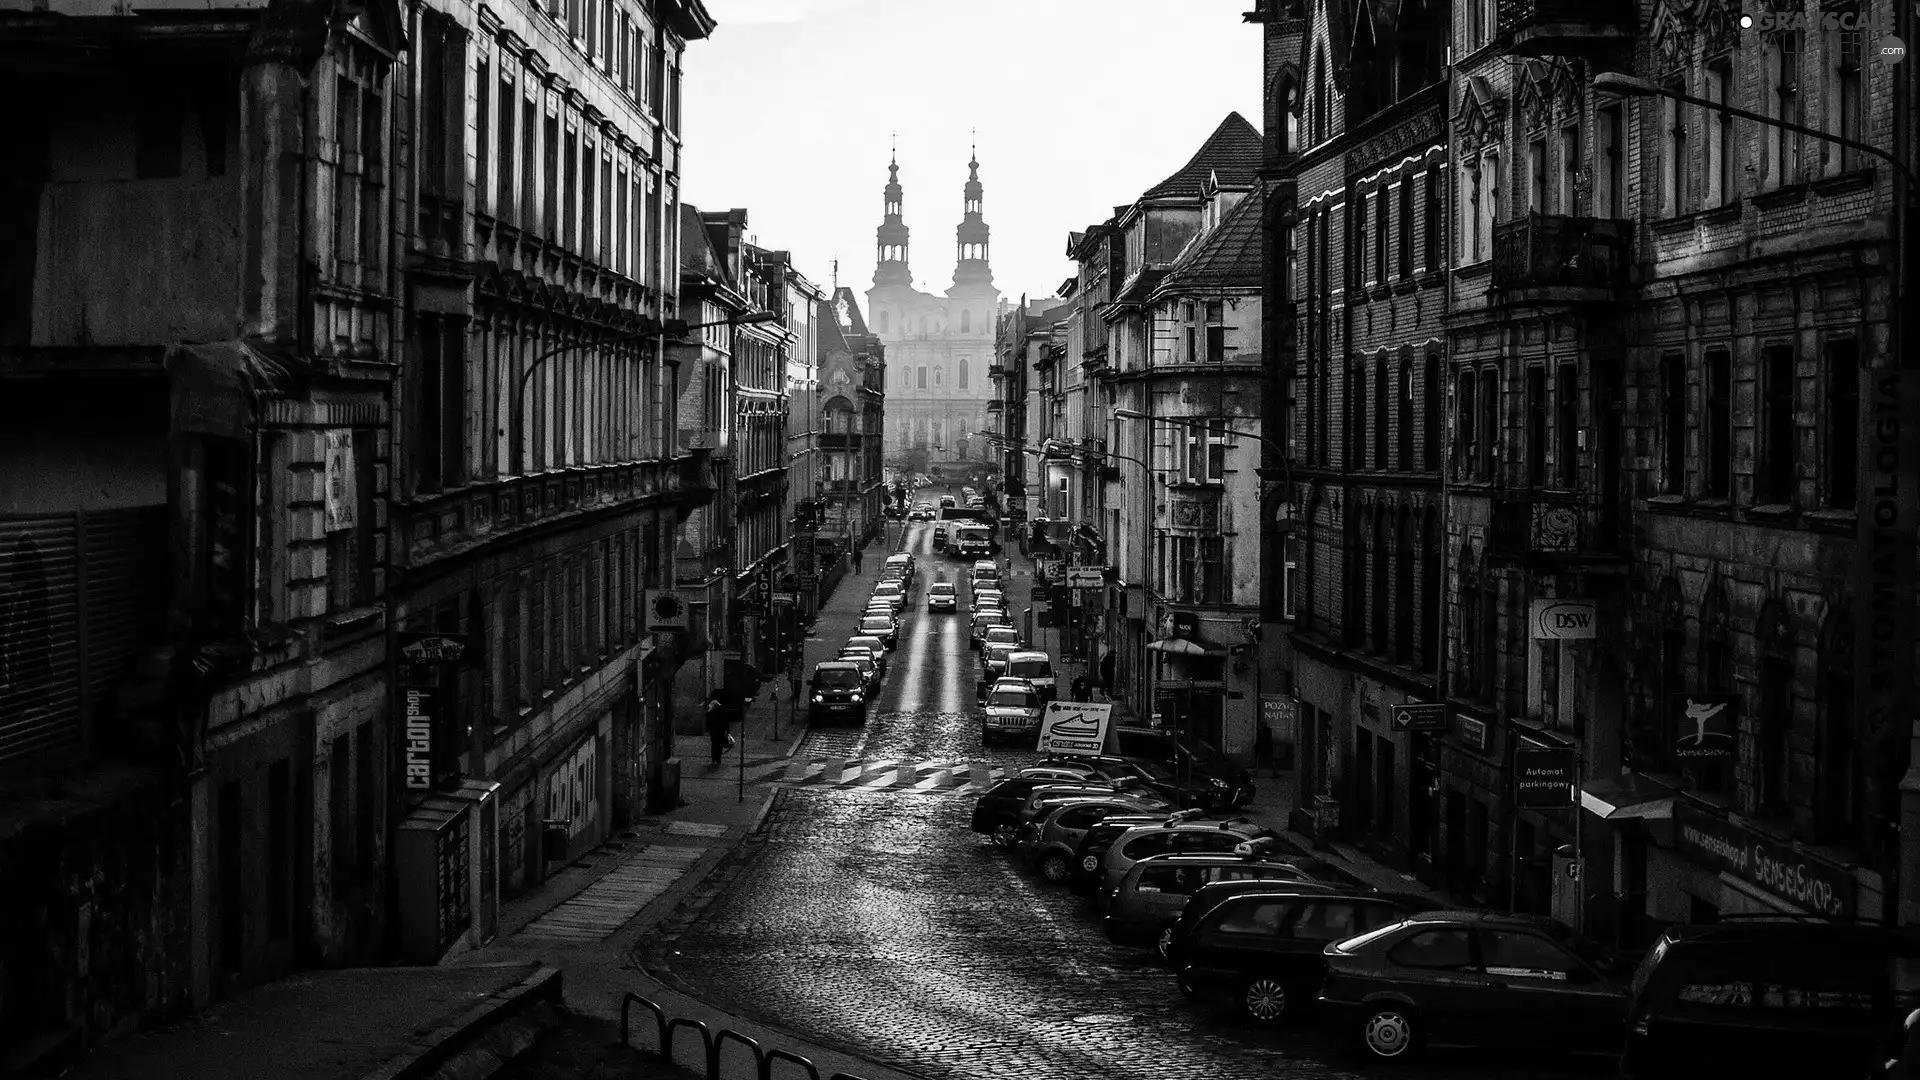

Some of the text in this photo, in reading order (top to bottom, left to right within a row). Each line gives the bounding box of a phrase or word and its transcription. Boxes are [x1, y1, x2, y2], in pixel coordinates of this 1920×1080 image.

[1868, 373, 1900, 694] STOMATOLOGIA
[1555, 613, 1592, 629] DSW
[1525, 768, 1563, 776] Automat
[1519, 780, 1569, 790] parkingowy
